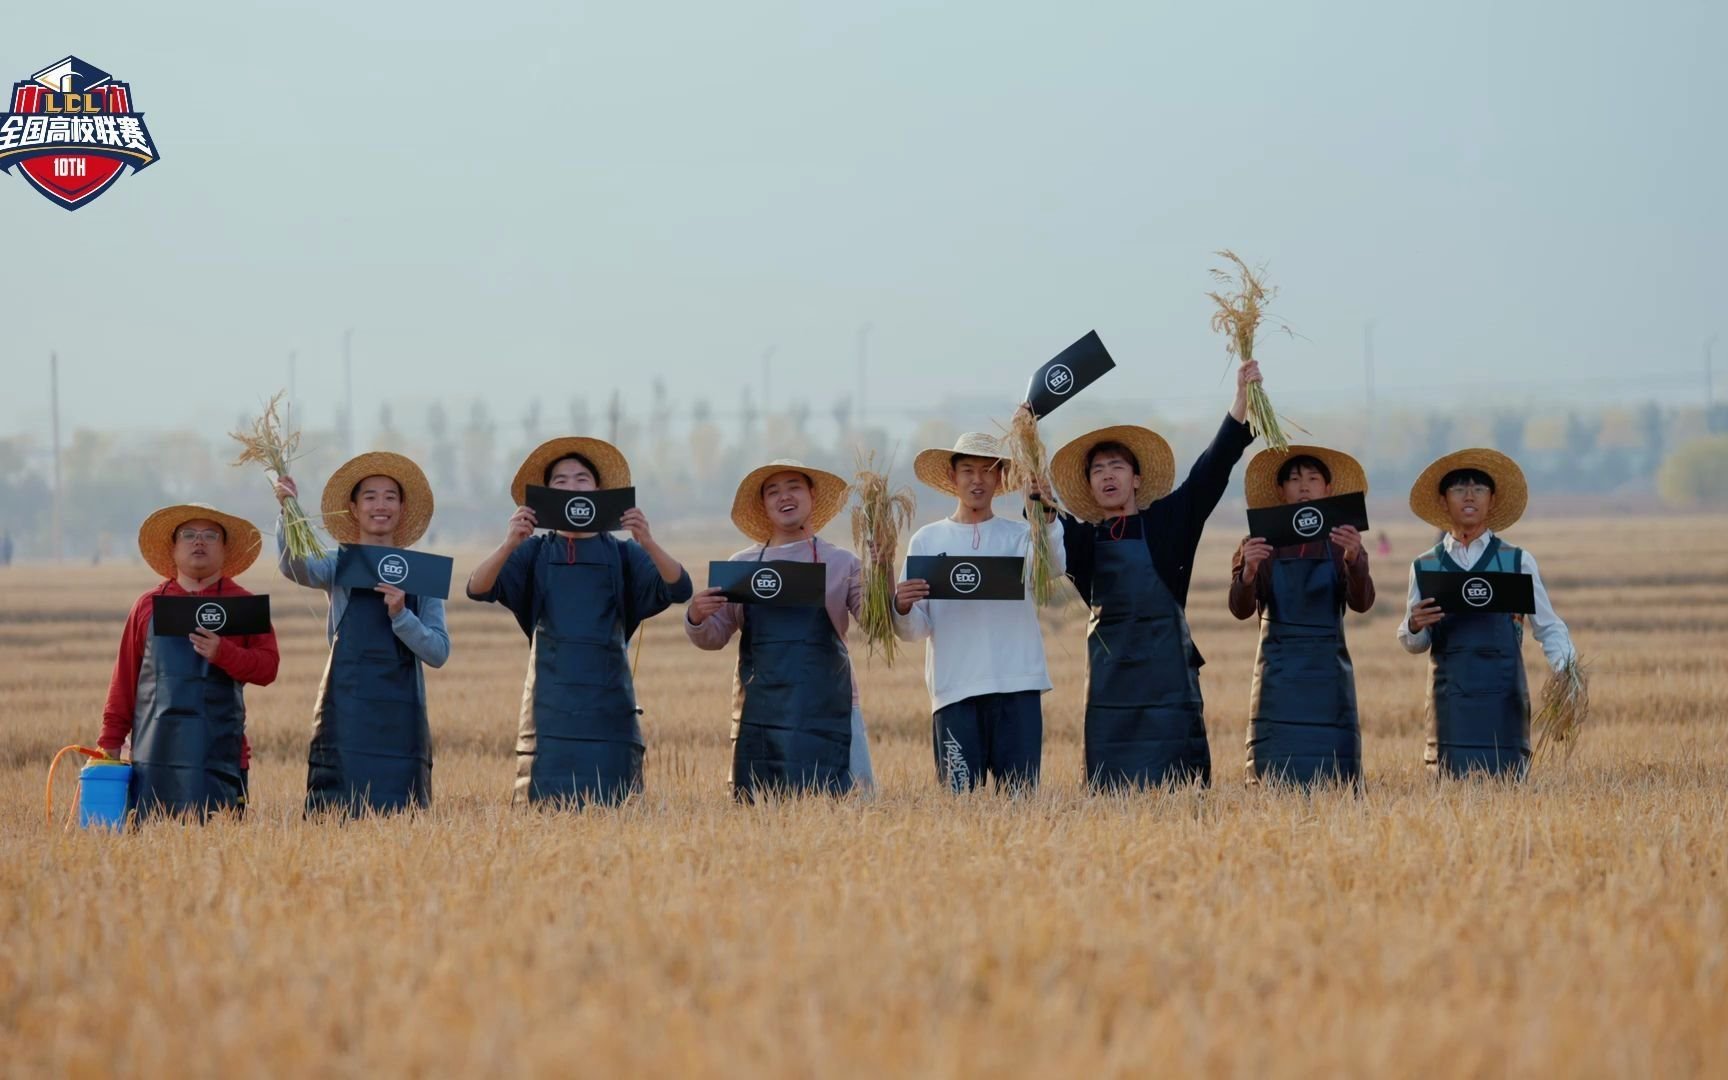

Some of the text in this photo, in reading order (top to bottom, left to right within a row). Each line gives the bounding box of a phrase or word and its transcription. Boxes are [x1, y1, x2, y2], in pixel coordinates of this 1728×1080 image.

[1050, 371, 1068, 387] EDG
[570, 507, 590, 516] EDG
[1298, 516, 1318, 527] EDG
[383, 564, 403, 574] EDG
[955, 574, 975, 583] EDG
[757, 579, 776, 588] EDG
[1467, 588, 1487, 597] EDG
[201, 613, 221, 622] EDG
